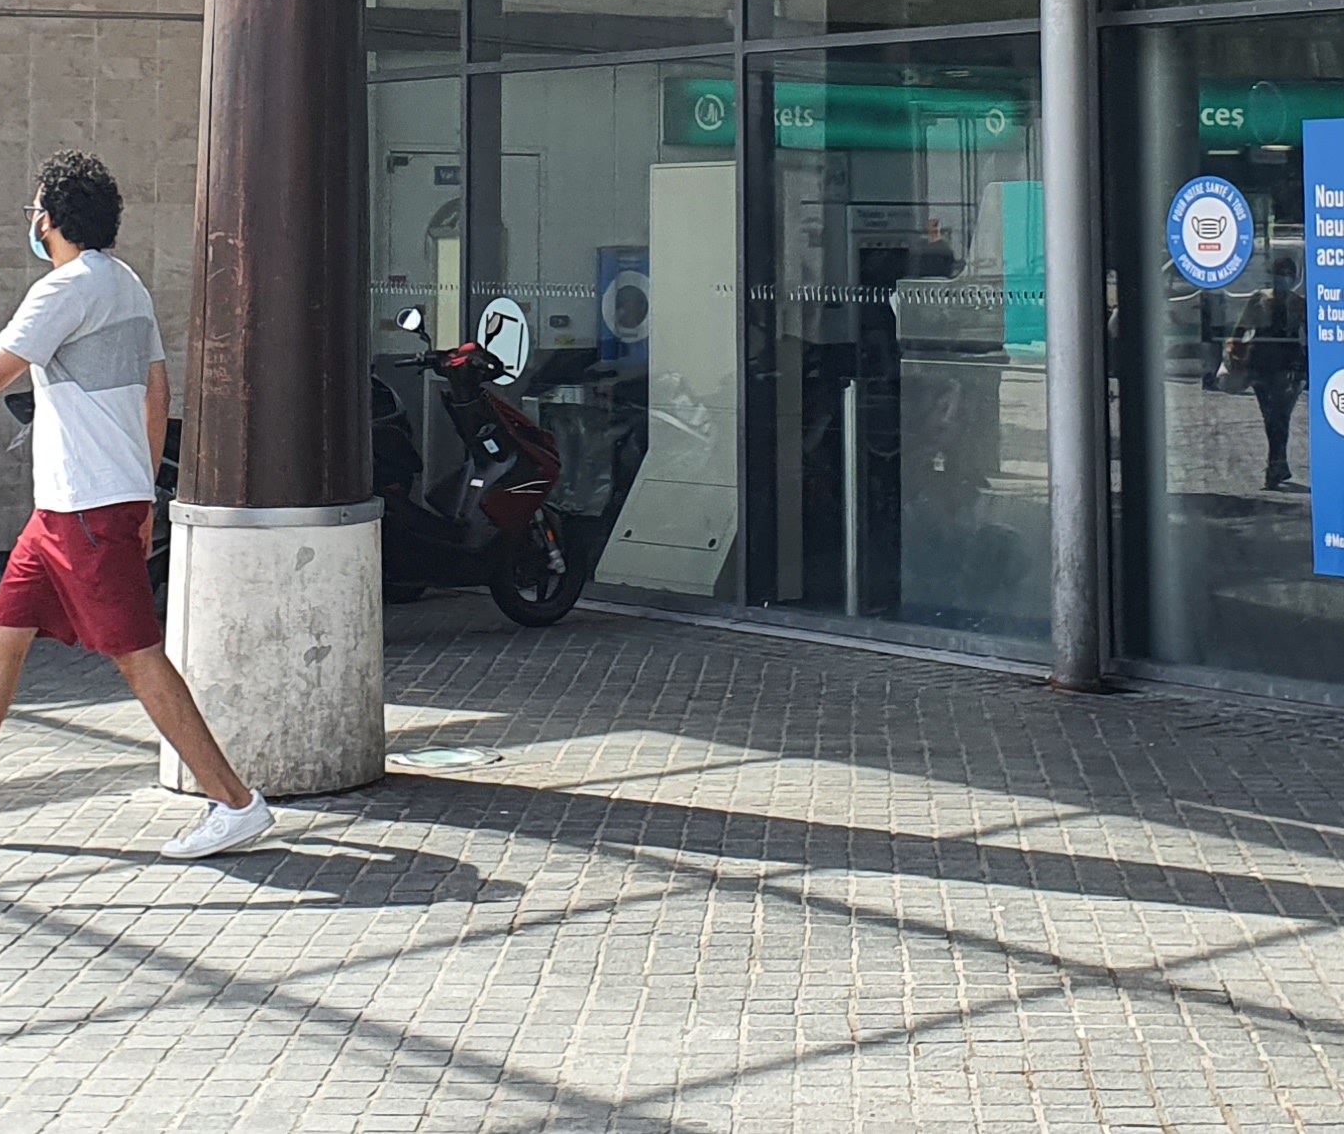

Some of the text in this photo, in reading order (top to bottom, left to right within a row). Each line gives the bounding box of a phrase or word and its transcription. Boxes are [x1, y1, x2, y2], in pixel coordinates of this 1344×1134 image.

[1200, 107, 1245, 127] ces
[1232, 197, 1248, 221] TOUS
[1316, 283, 1342, 302] Pour
[1318, 304, 1325, 321] à
[1318, 324, 1335, 341] les
